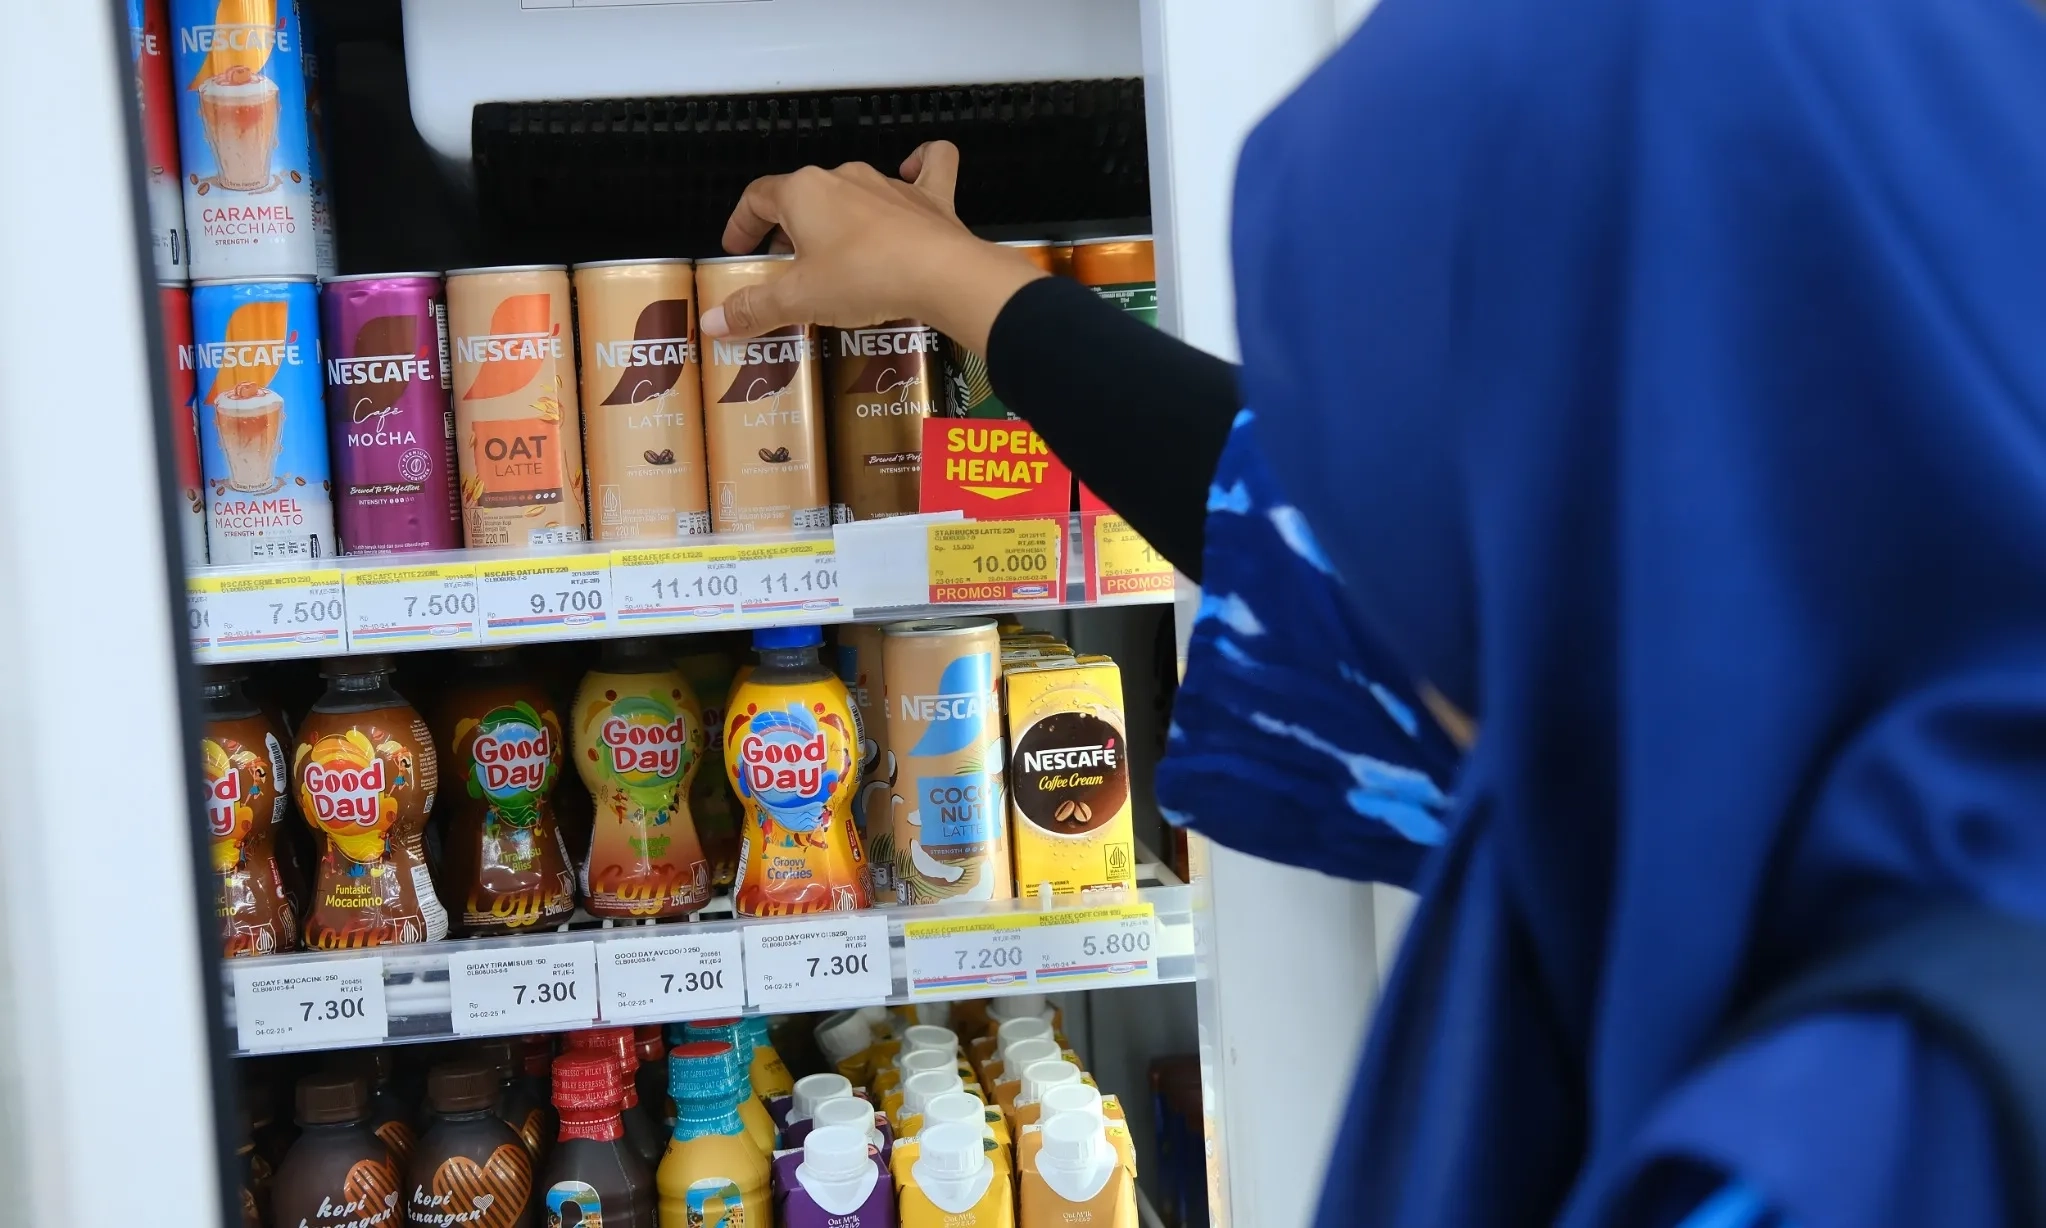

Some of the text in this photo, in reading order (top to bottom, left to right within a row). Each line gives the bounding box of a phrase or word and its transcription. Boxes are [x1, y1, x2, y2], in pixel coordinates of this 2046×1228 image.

[181, 17, 290, 54] NESCAFÉ
[203, 206, 294, 223] CARAMEL
[204, 222, 295, 236] MACCHIATO
[198, 330, 302, 369] NESCAFÉ
[457, 323, 565, 364] NESCAFÉ
[328, 345, 434, 385] NESCAFÉ
[856, 400, 938, 418] ORIGINAL
[628, 413, 685, 429] LATTE
[744, 411, 801, 427] LATTE
[348, 431, 416, 447] MOCHA
[947, 427, 1048, 455] SUPER
[484, 435, 547, 461] OAT
[495, 462, 543, 477] LATTE
[946, 459, 1048, 484] HEMAT
[214, 499, 302, 516] CARAMEL
[216, 514, 303, 529] MACCHIATO
[486, 531, 509, 544] 220 ml
[935, 528, 979, 536] STARBUCKS
[532, 567, 554, 575] LATTE
[972, 554, 1047, 573] 10.000
[652, 575, 738, 599] 11.100
[936, 586, 1006, 600] PROMOSI
[404, 593, 476, 617] 7.500
[530, 589, 602, 614] 9.700
[269, 599, 342, 624] 7.500
[603, 717, 684, 745] Good
[475, 731, 549, 763] Good
[742, 734, 825, 763] Good
[1024, 738, 1116, 773] NESCAFÉ
[614, 746, 679, 776] Day
[305, 761, 384, 795] Good
[487, 764, 545, 791] Day
[753, 766, 819, 795] Day
[1039, 772, 1103, 791] Coffee Cream
[929, 787, 991, 805] COCO
[316, 796, 379, 825] Day
[941, 804, 983, 823] NUT
[943, 823, 984, 838] LATTE
[930, 847, 963, 855] STRENGTH
[512, 861, 532, 872] Bliss
[773, 857, 806, 869] Groovy
[767, 867, 812, 880] Cookies
[335, 884, 371, 894] Funtastic
[325, 895, 383, 908] Mocacinno
[671, 895, 684, 907] 250
[684, 893, 693, 903] ml
[784, 933, 800, 941] DAY
[800, 932, 820, 940] GRVY
[1083, 931, 1150, 956] 5.800
[615, 952, 637, 960] GOOD
[638, 950, 653, 958] DAY
[955, 946, 1023, 970] 7.200
[764, 982, 792, 990] 04-02-25
[470, 1010, 499, 1018] 04-02-25
[256, 1027, 285, 1035] 04-02-25
[561, 1079, 605, 1089] MILKY ESPRESSO
[581, 1123, 606, 1135] ESPRESSO
[413, 1184, 453, 1206] kopi
[317, 1194, 367, 1219] kopi
[828, 1217, 842, 1226] Oat
[1063, 1212, 1077, 1220] Oat
